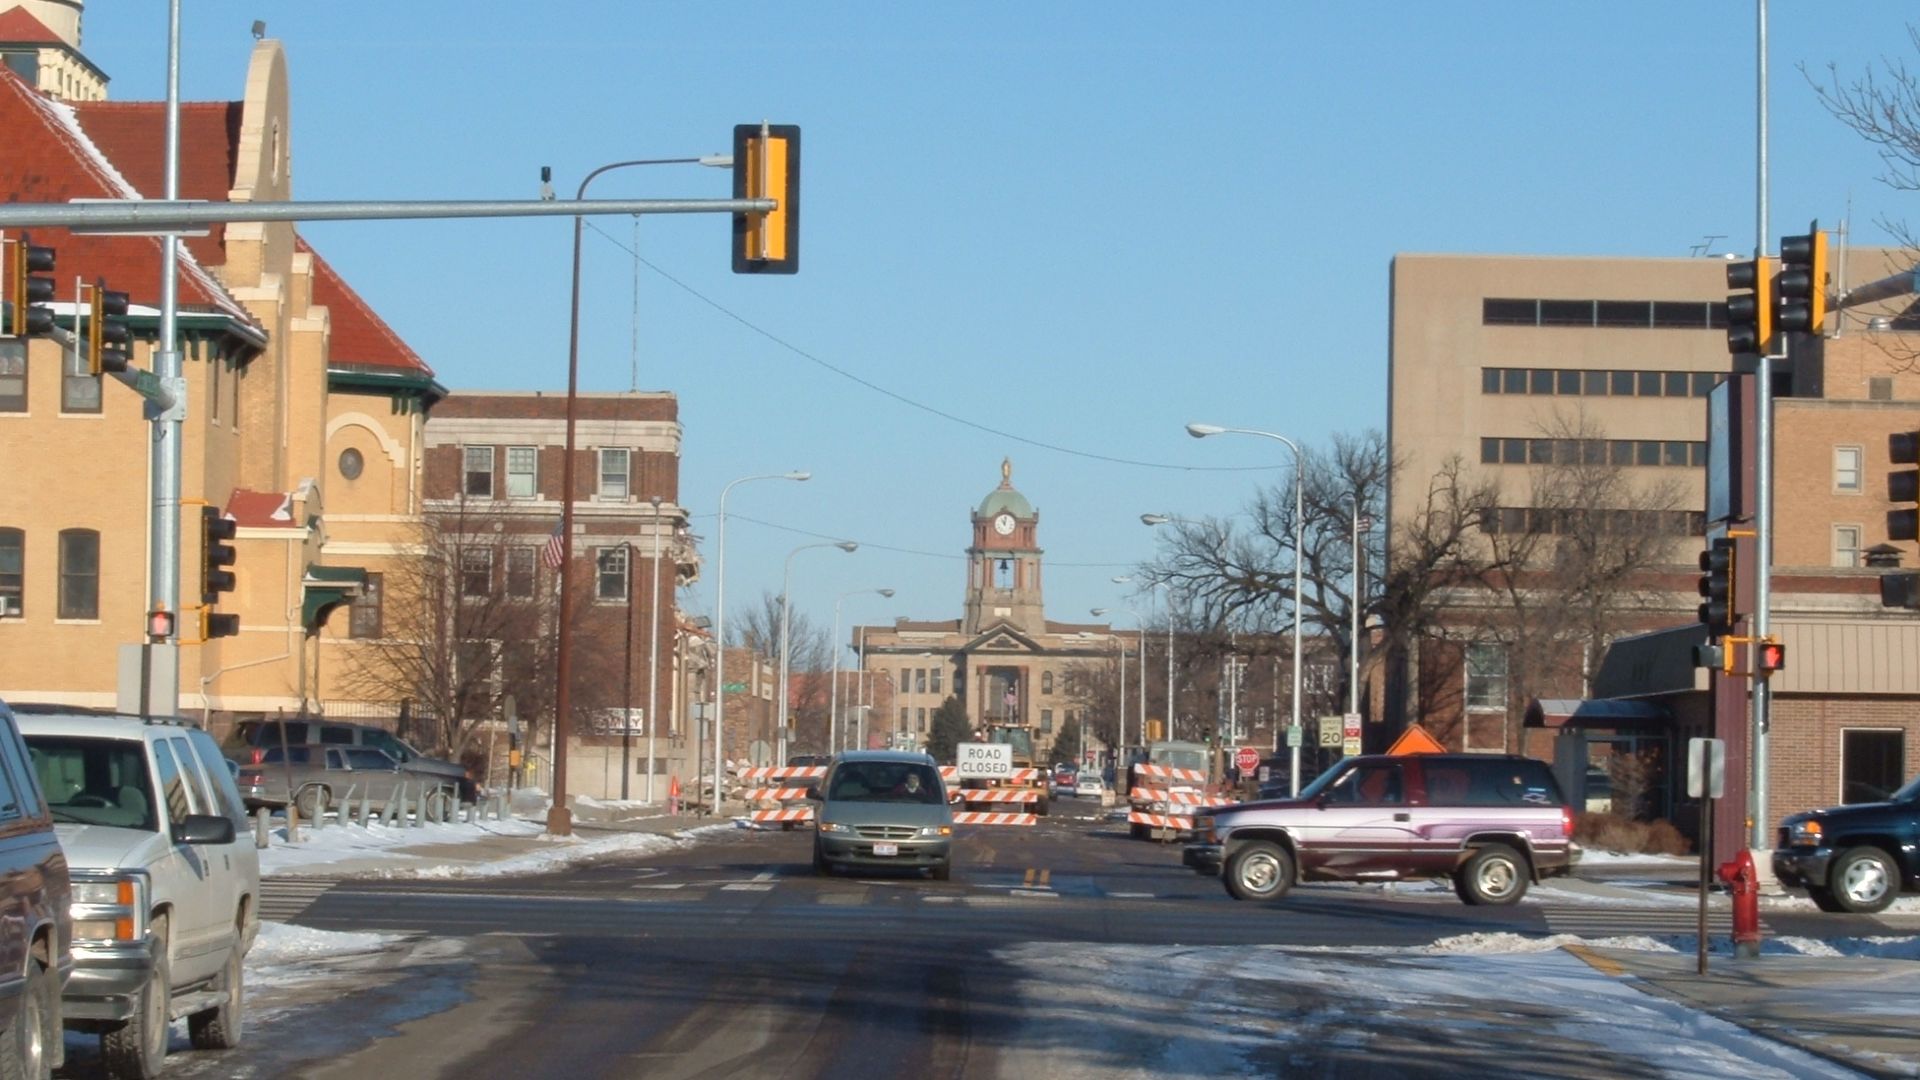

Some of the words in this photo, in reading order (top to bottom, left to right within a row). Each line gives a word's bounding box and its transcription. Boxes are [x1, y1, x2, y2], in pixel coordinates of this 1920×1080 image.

[1322, 732, 1341, 743] 20
[968, 748, 1001, 759] ROAD
[1237, 754, 1258, 764] STOP
[961, 762, 1007, 773] CLOSED
